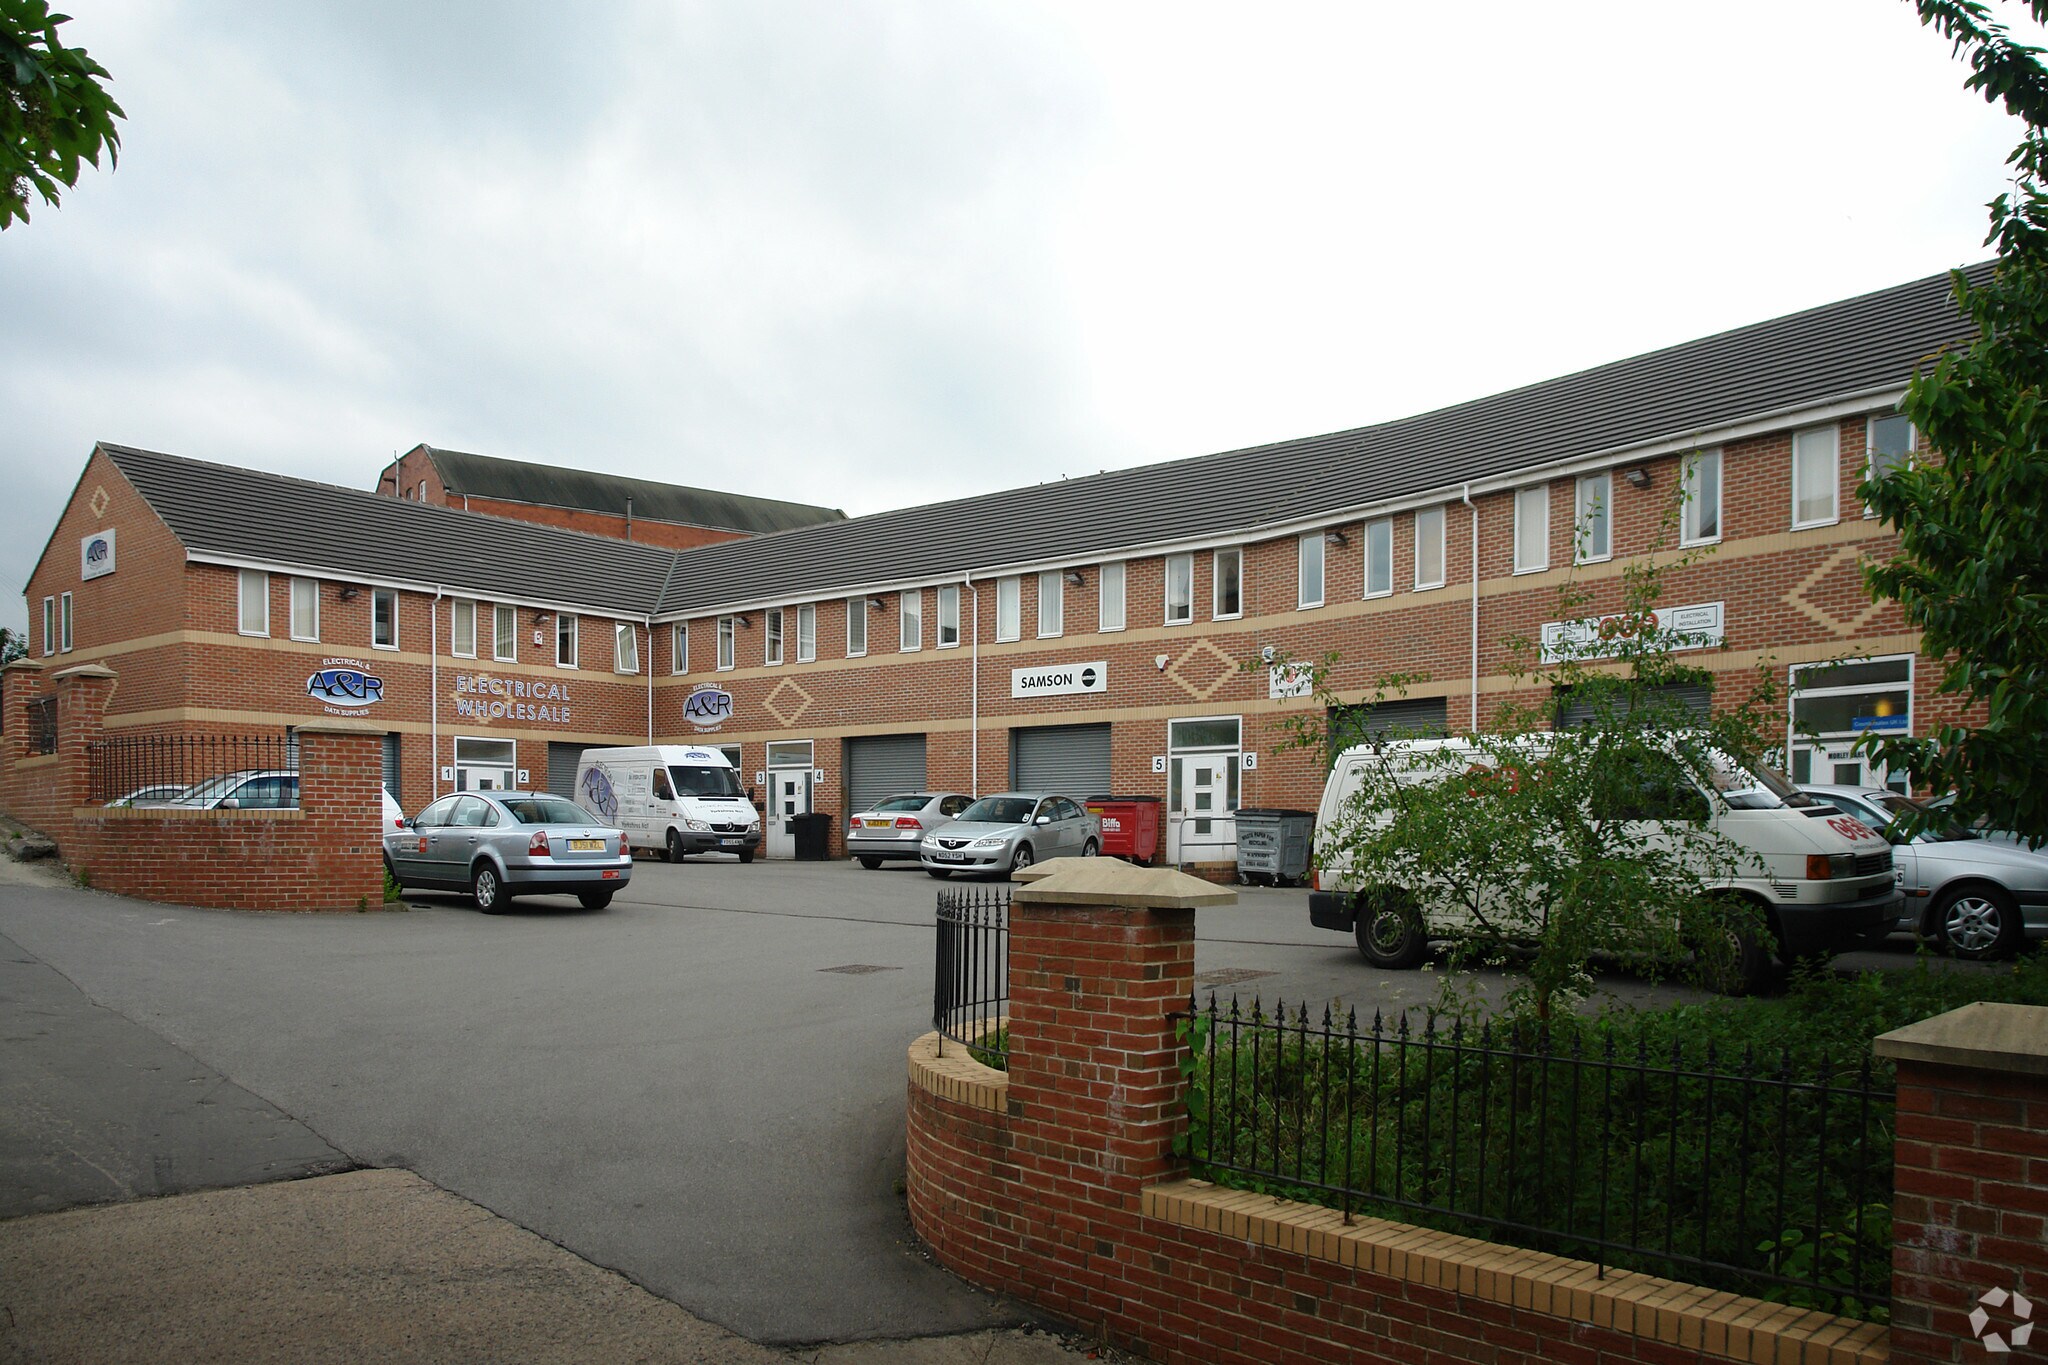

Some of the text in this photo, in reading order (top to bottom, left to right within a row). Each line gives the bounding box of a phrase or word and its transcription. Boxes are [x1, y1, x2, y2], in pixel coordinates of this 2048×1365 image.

[1681, 611, 1709, 619] ELECTRICAL
[1678, 618, 1712, 627] INSTALLATION
[323, 658, 364, 669] ELECTRICAL
[306, 671, 384, 701] A&R
[1020, 673, 1073, 689] SAMSON
[456, 675, 570, 701] ELECTRICAL
[324, 706, 369, 716] DATA SUPPLIES
[456, 699, 570, 723] WHOLESALE
[684, 694, 730, 718] A&R
[1850, 750, 1865, 759] ARS
[1155, 758, 1163, 770] 5
[1246, 755, 1253, 767] 6
[445, 768, 450, 779] 1
[520, 771, 527, 781] 2
[758, 773, 763, 783] 3
[816, 771, 822, 781] 4
[1102, 817, 1121, 828] Biffa
